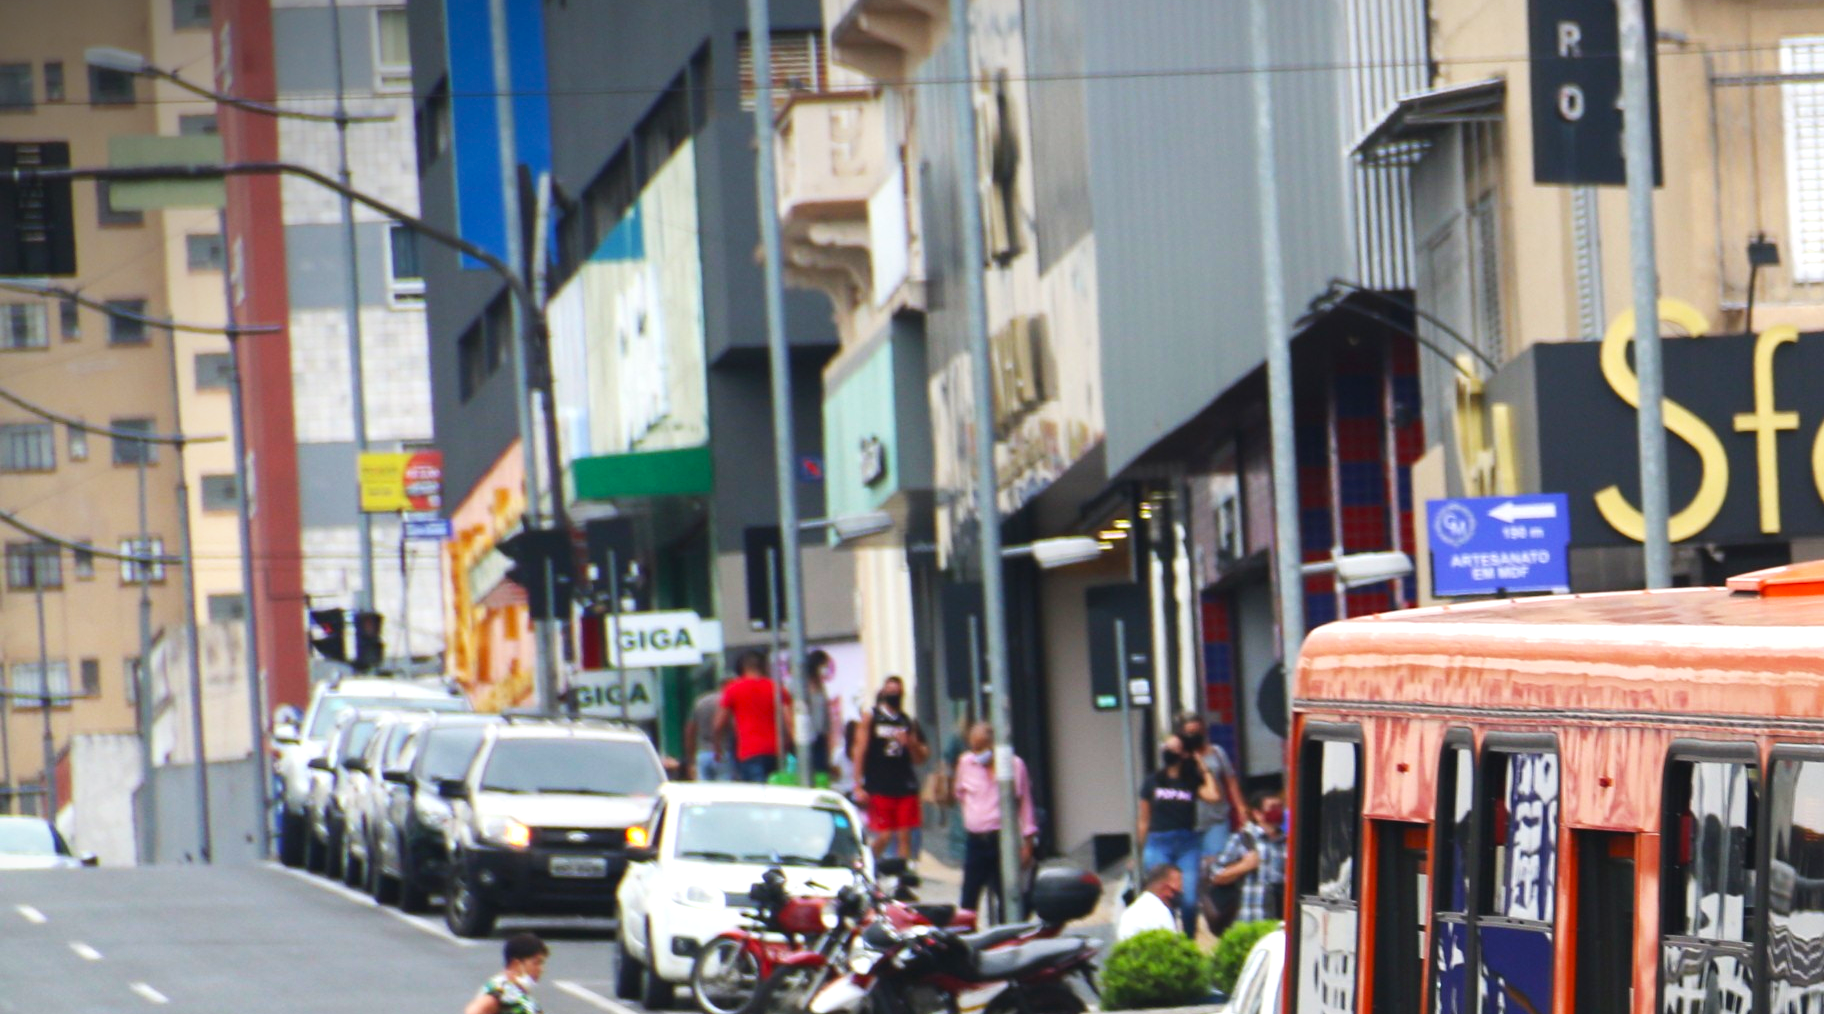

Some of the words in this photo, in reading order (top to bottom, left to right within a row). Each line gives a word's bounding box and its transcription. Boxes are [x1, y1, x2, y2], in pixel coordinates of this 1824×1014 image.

[1451, 550, 1551, 568] ARTESANATO
[1471, 567, 1496, 582] EM
[1497, 565, 1530, 581] MDF
[620, 627, 695, 651] GIGA
